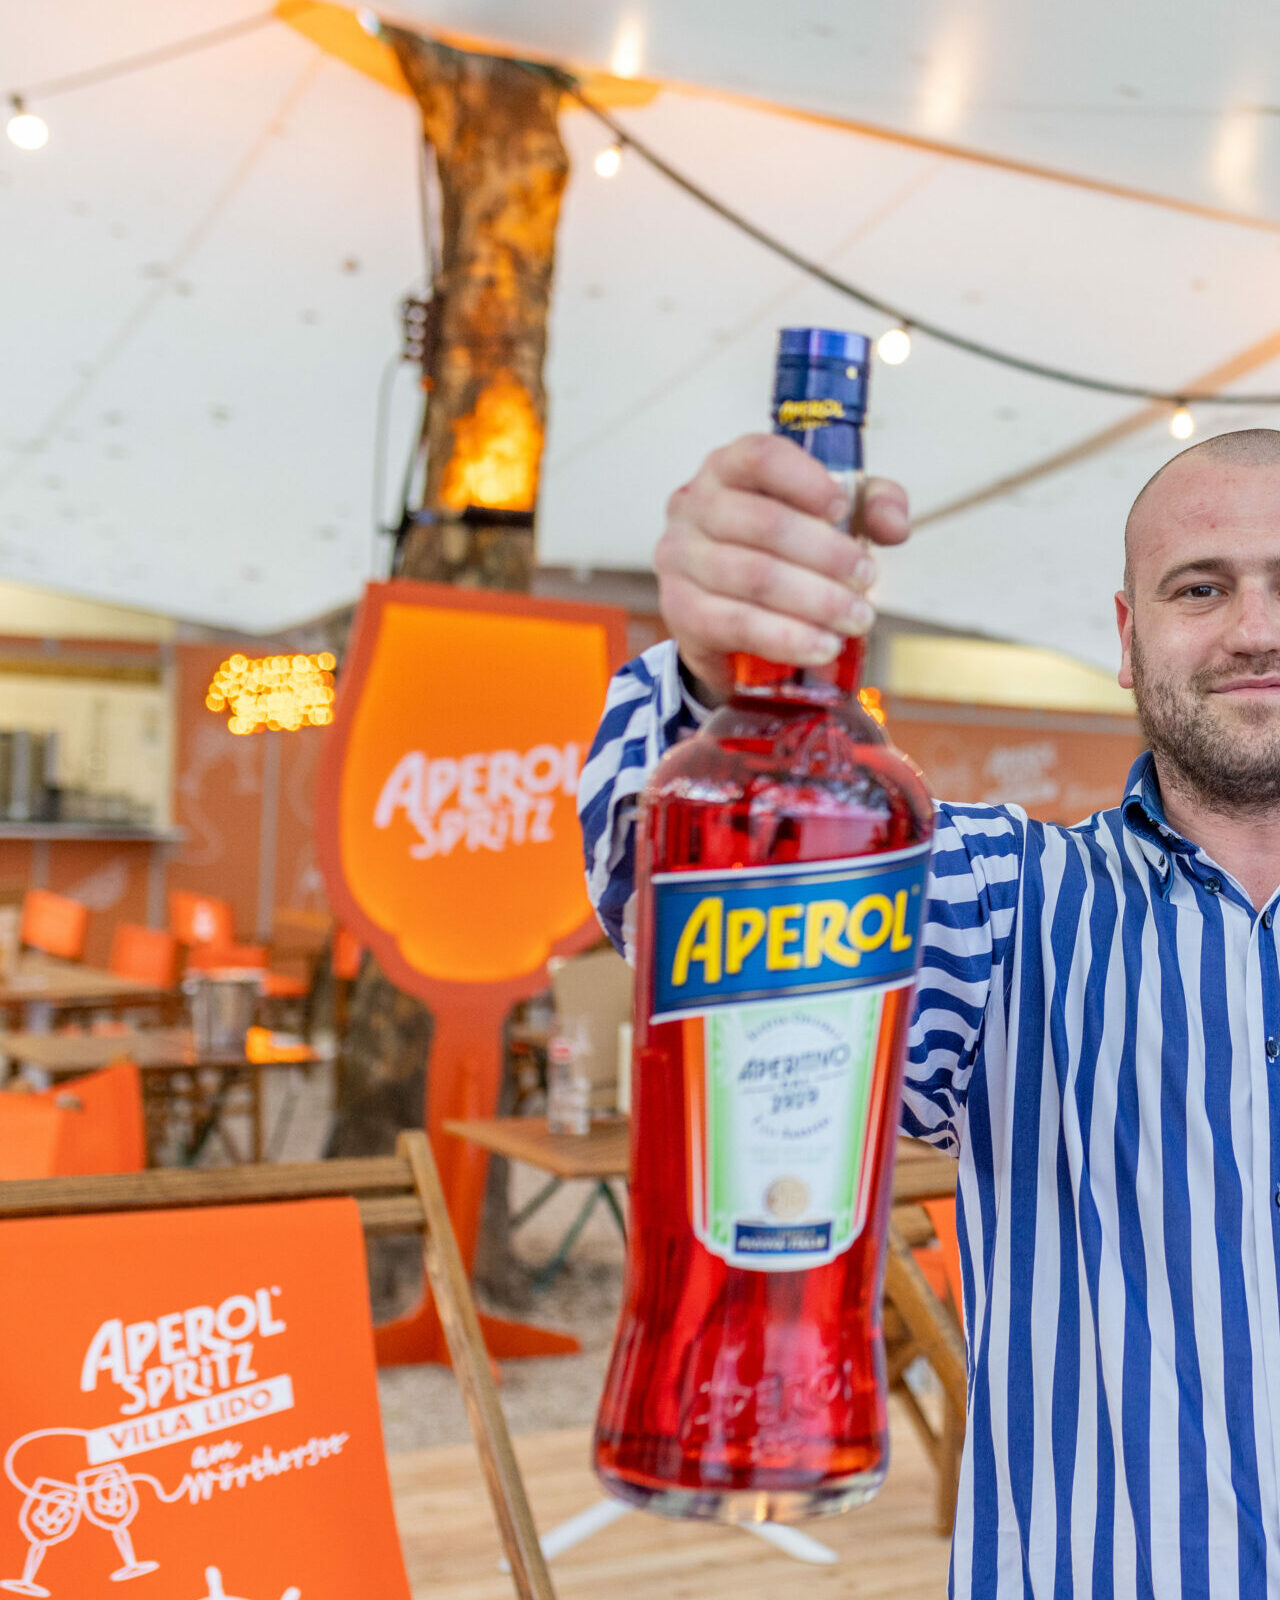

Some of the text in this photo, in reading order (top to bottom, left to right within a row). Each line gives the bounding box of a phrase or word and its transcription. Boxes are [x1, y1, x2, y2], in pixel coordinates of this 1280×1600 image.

[671, 890, 913, 986] APEROL
[80, 1288, 287, 1393] APEROL
[108, 1387, 273, 1451] VILLA LIDO
[190, 1439, 243, 1470] am
